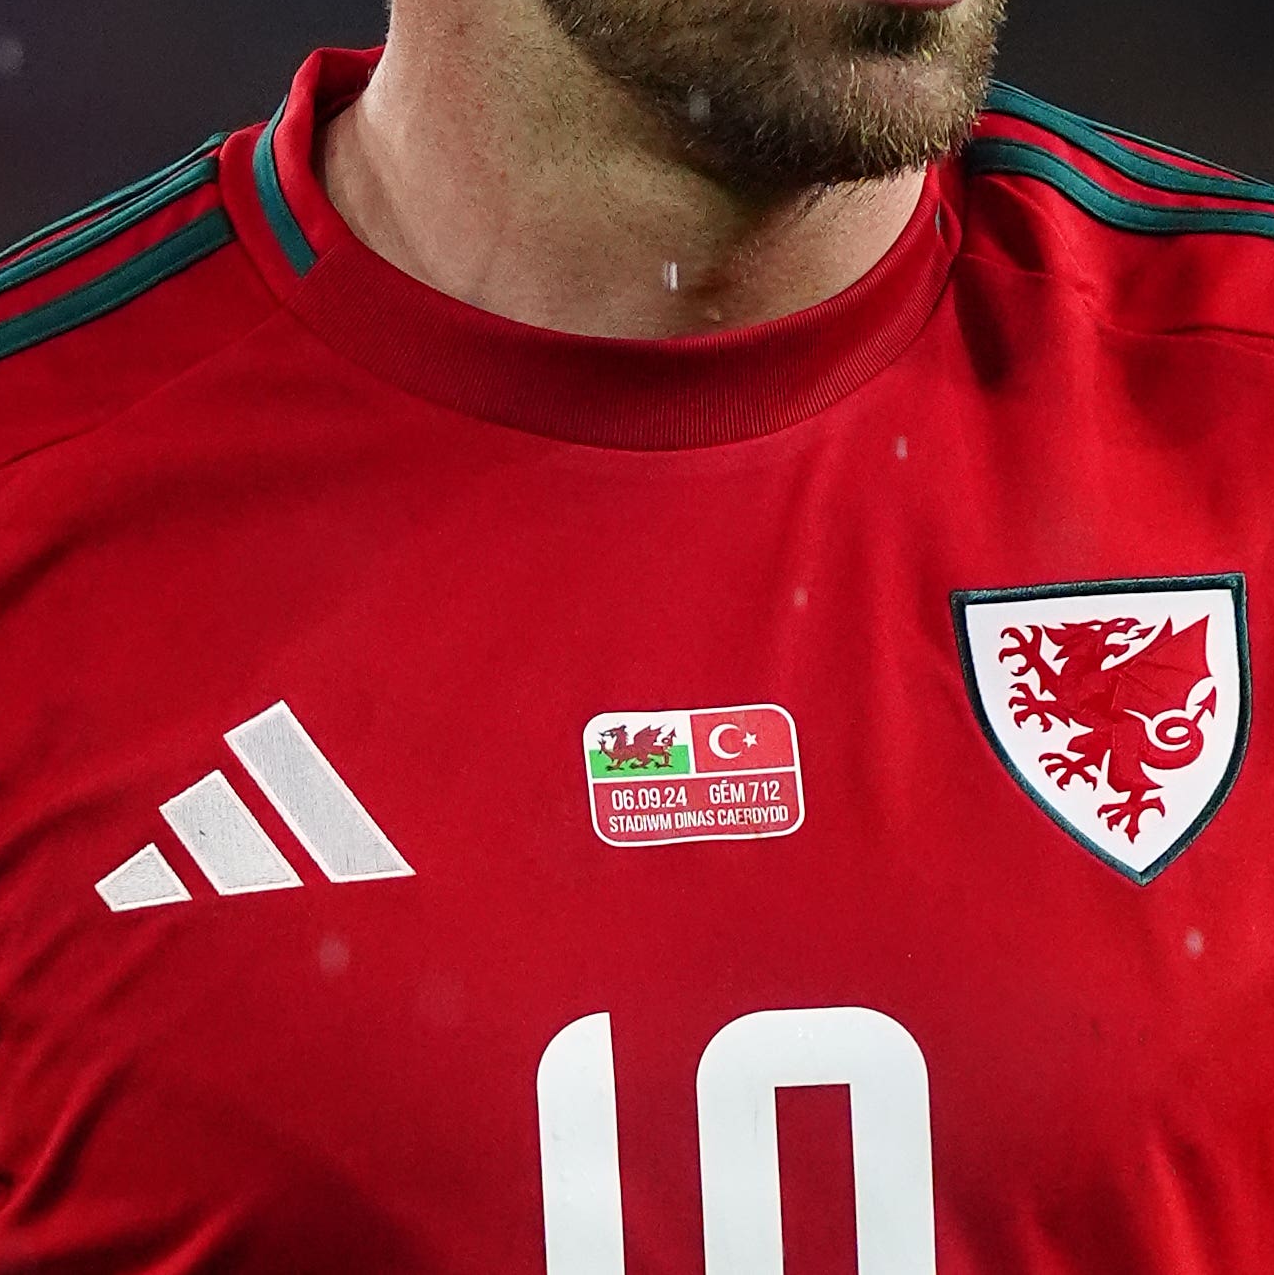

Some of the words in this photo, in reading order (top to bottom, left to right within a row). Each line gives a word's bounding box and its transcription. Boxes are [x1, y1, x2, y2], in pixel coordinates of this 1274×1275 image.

[611, 786, 688, 811] 06.09.24
[748, 779, 781, 803] 712
[608, 812, 672, 833] STADIWM
[677, 809, 716, 829] DINAS
[717, 805, 789, 826] CAERDYDD
[536, 1006, 936, 1275] 10
